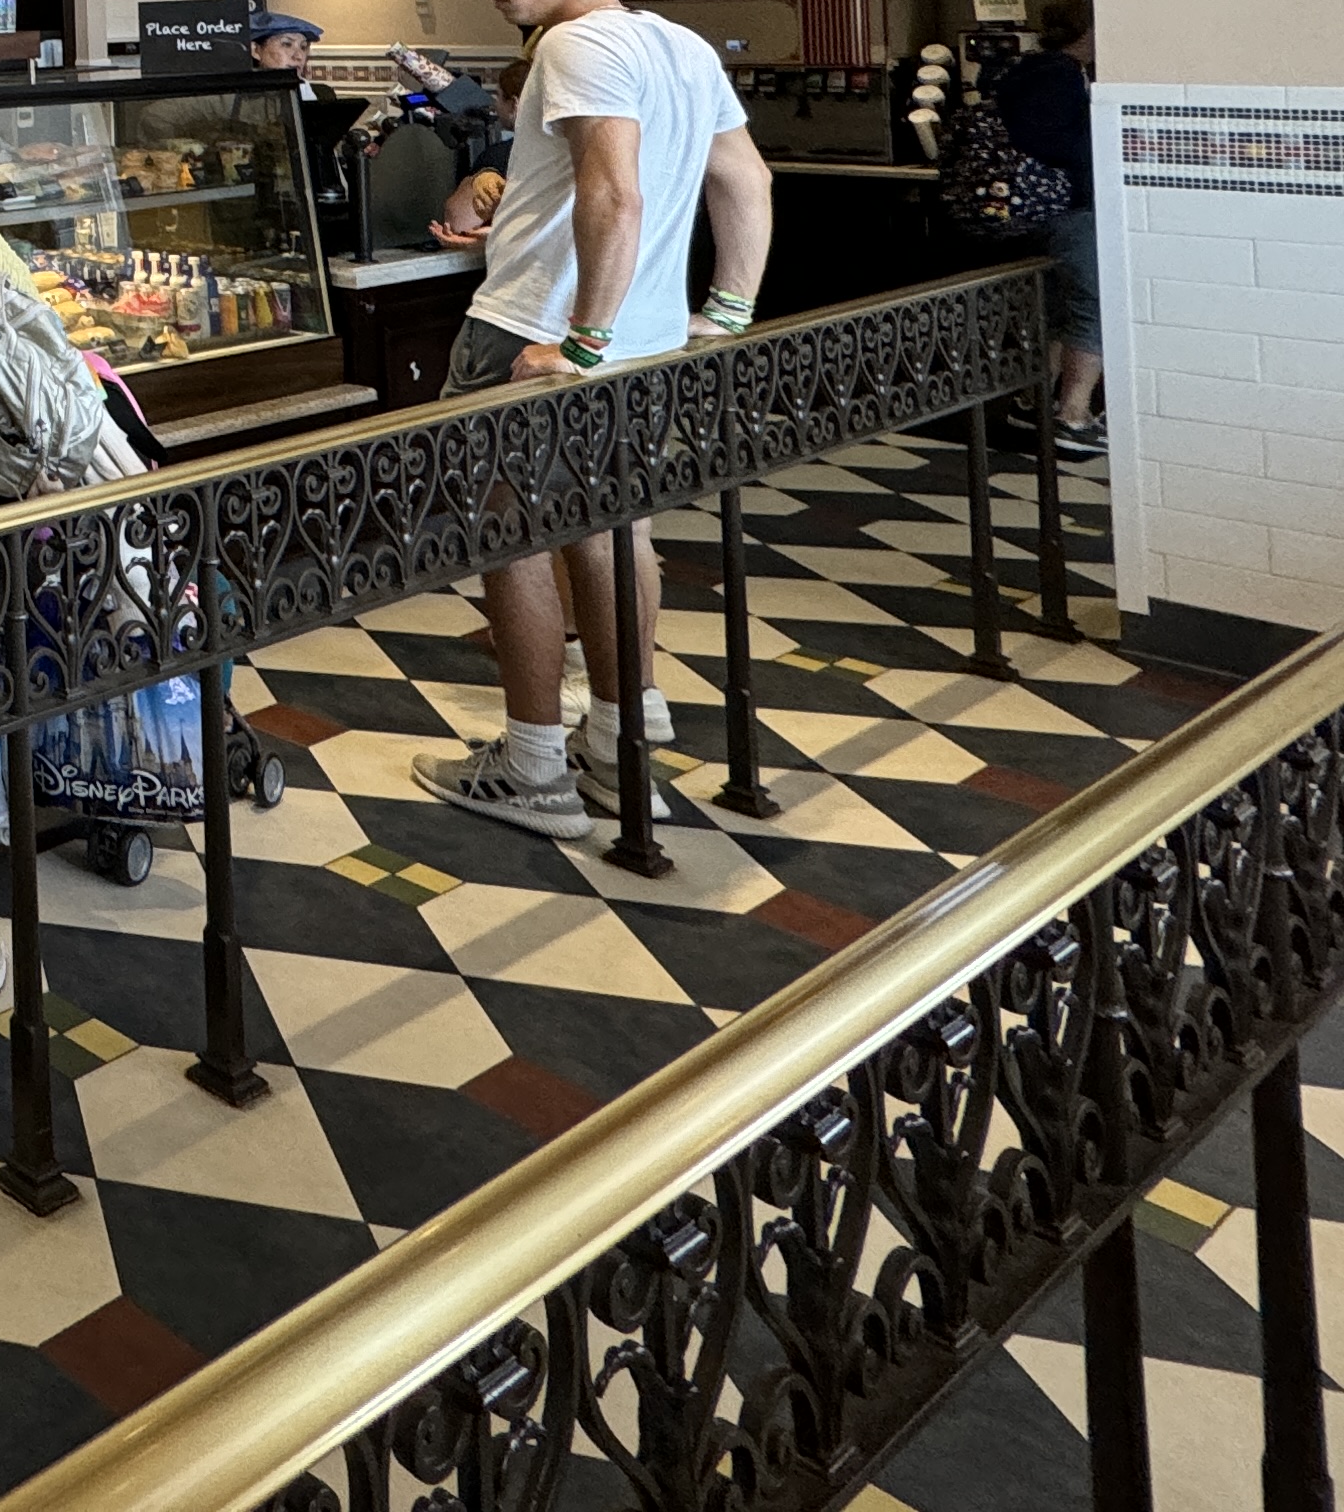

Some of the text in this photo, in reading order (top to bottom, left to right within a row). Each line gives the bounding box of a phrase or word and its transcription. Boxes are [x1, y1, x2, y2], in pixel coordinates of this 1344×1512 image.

[145, 19, 243, 36] Place Order
[176, 38, 212, 51] Here
